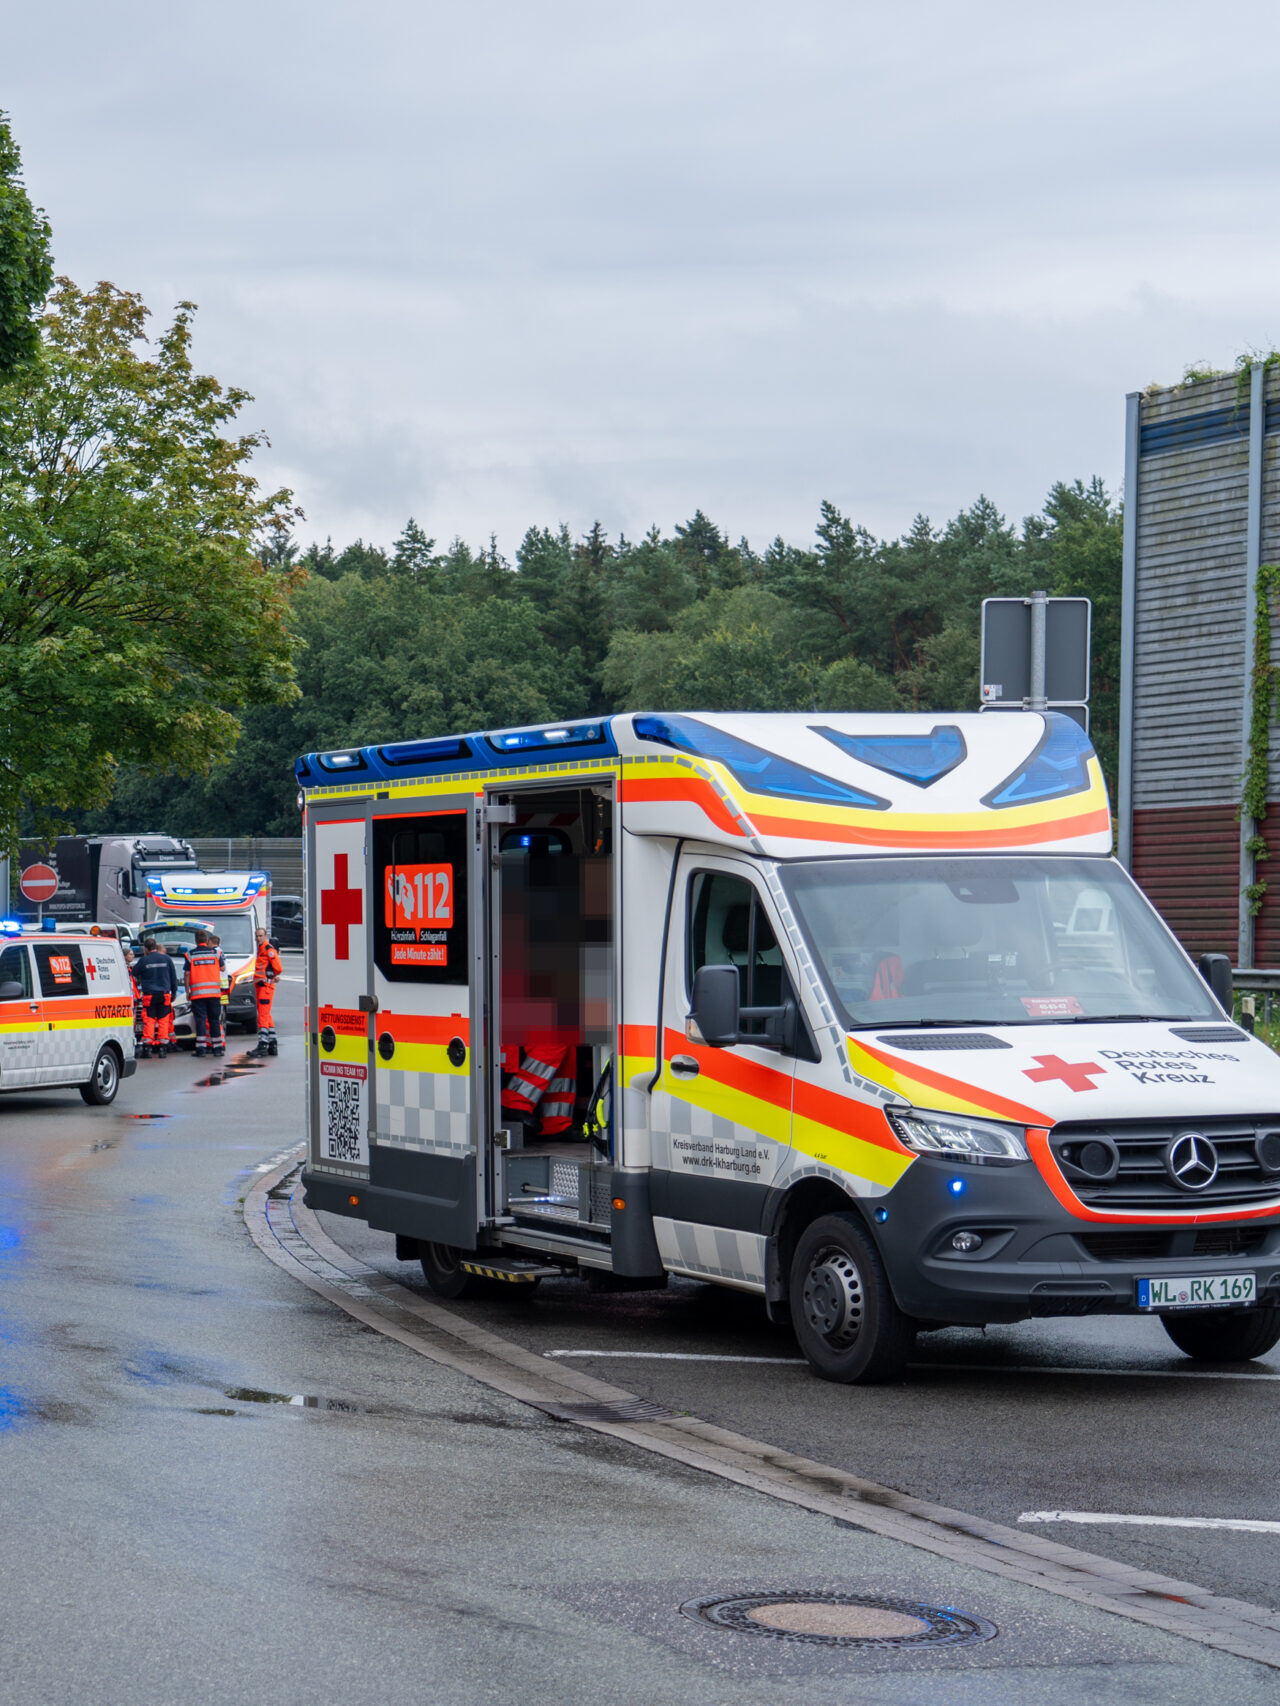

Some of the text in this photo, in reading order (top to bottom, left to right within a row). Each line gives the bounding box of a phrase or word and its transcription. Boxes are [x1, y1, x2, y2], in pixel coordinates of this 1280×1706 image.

[414, 872, 450, 919] 112
[420, 930, 447, 944] Schlaganfall
[394, 947, 444, 961] Jede Minute zählt!
[95, 1004, 131, 1019] NOTARZT
[321, 1013, 365, 1025] RETTUNGSDIENST
[1097, 1049, 1240, 1062] Deutsches
[323, 1064, 335, 1074] KOMM
[344, 1066, 356, 1076] TEAM
[1114, 1060, 1198, 1070] Rotes
[1131, 1071, 1216, 1084] Kreuz
[673, 1138, 770, 1160] Kreisverband Harburg Land e.V.
[682, 1155, 761, 1175] www.drk-lkharburg.de
[1150, 1281, 1177, 1303] WL
[1190, 1279, 1215, 1302] RK
[1220, 1277, 1254, 1300] 169
